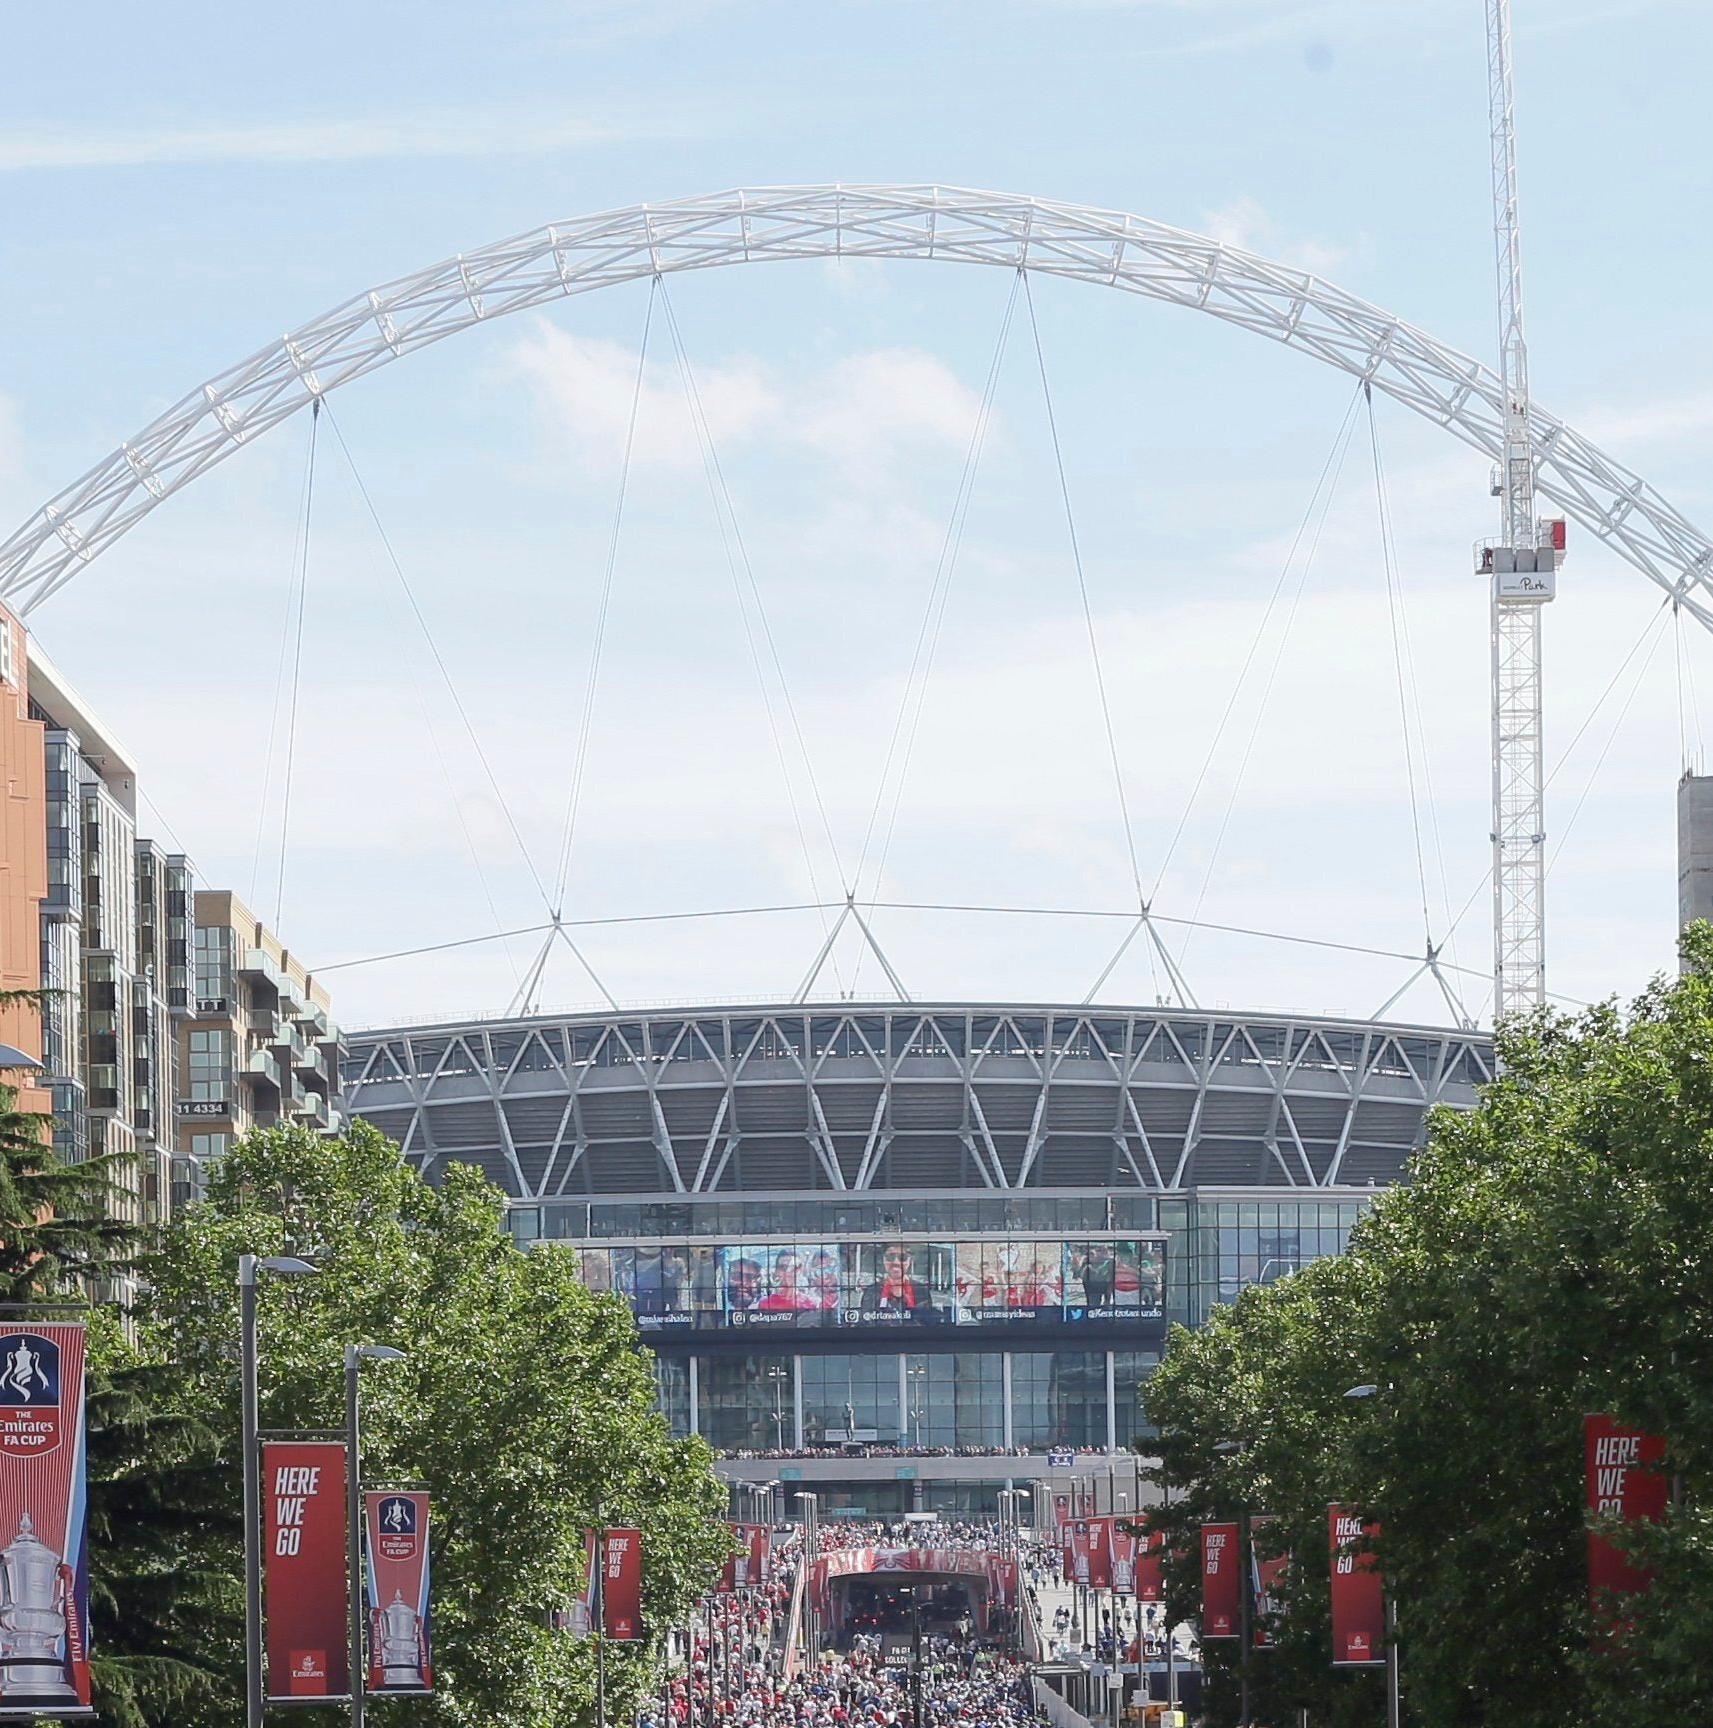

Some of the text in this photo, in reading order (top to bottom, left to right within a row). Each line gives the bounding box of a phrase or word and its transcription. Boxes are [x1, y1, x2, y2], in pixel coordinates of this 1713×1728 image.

[15, 1411, 32, 1419] THE
[4, 1435, 46, 1446] FA CUP
[1595, 1437, 1641, 1466] HERE
[275, 1467, 321, 1495] HERE
[1597, 1468, 1626, 1496] WE
[277, 1497, 307, 1526] WE
[275, 1527, 302, 1556] GO
[608, 1538, 629, 1551] HERE
[1206, 1533, 1226, 1548] HERE
[608, 1552, 622, 1565] WE
[1206, 1548, 1220, 1562] WE
[608, 1565, 620, 1578] GO
[1206, 1562, 1218, 1574] GO
[1336, 1555, 1353, 1574] GO
[66, 1589, 83, 1662] Fly Emirates
